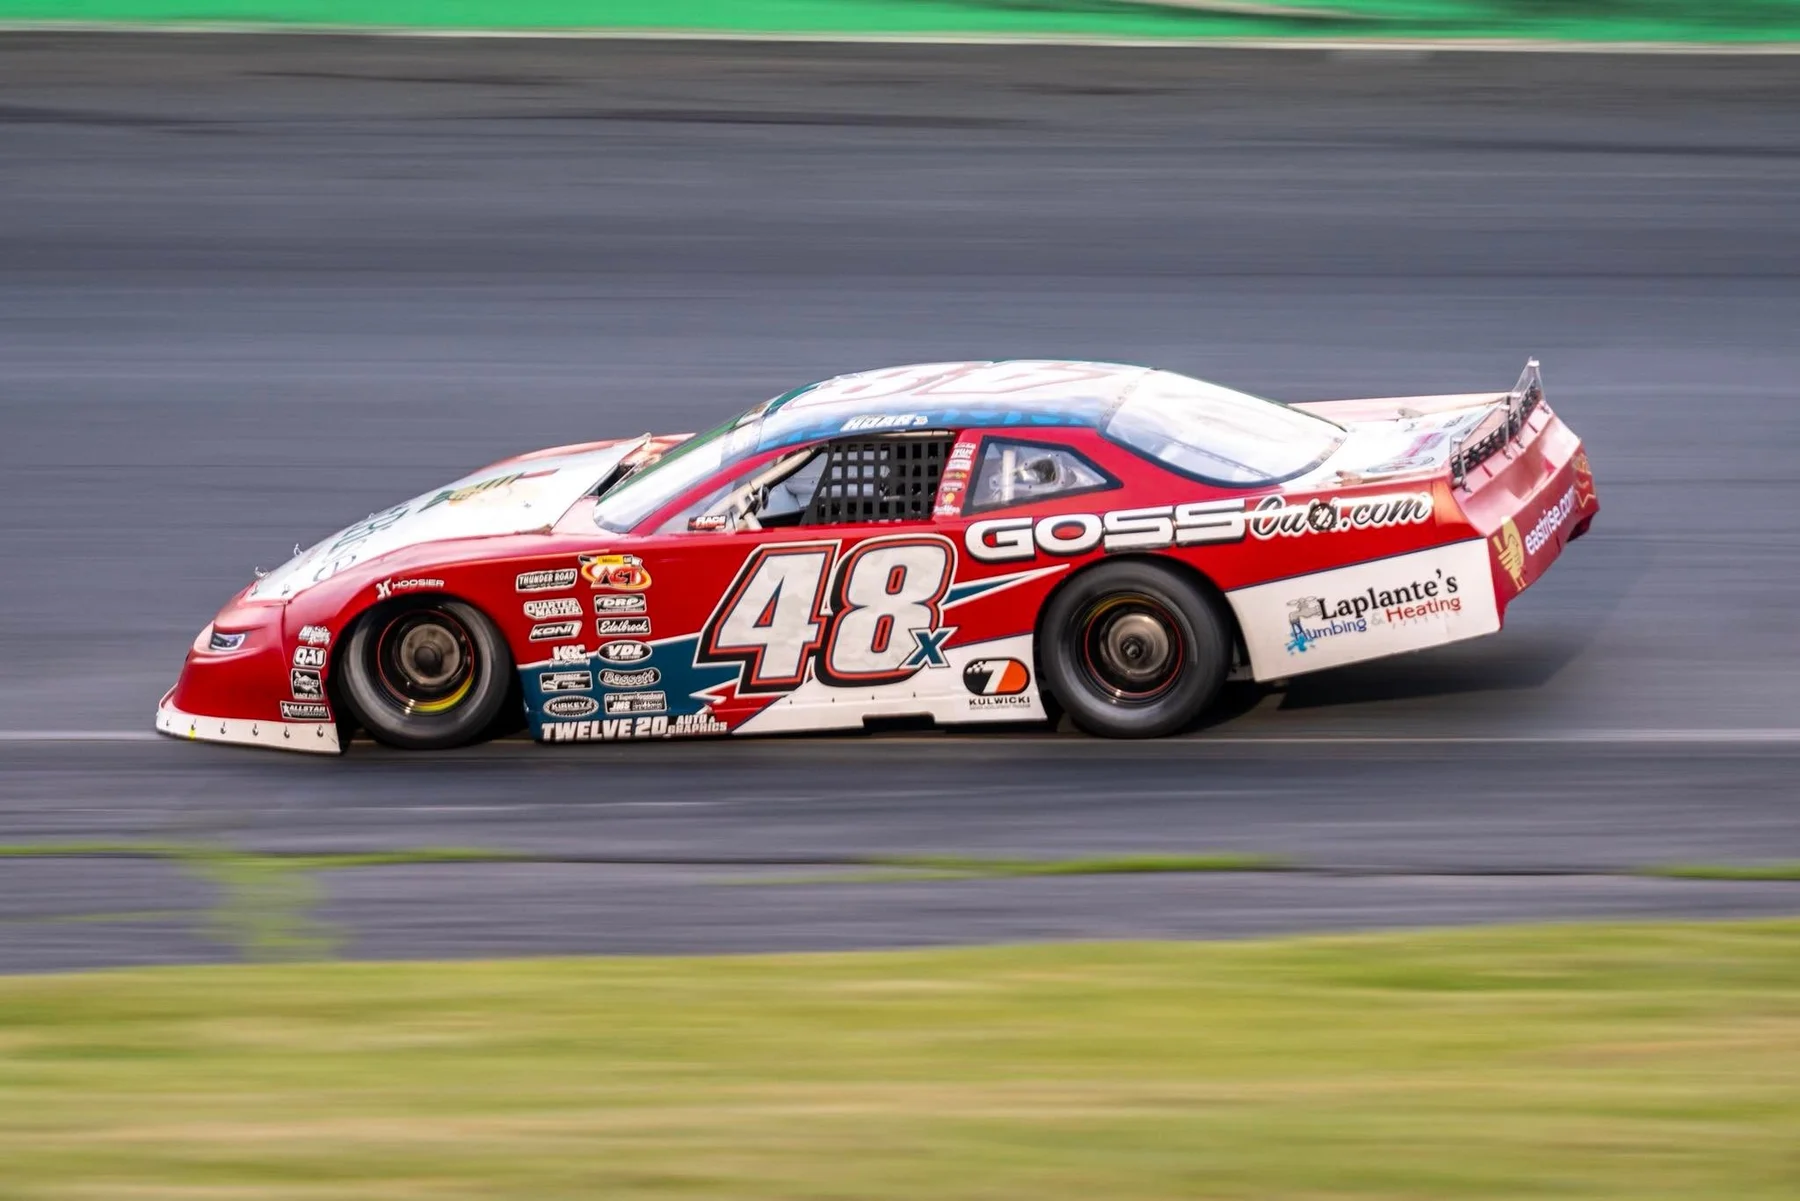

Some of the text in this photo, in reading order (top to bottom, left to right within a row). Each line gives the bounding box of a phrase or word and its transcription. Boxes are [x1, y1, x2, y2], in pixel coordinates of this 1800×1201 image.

[965, 499, 1246, 563] GOSS
[519, 573, 554, 585] THUNDER
[554, 571, 575, 581] ROAD
[593, 565, 643, 586] ACT
[392, 578, 445, 589] HOOSIER
[1317, 569, 1459, 620] Laplante's
[526, 600, 578, 614] QUARTER
[603, 597, 639, 607] DRP
[535, 606, 581, 618] MASTER
[706, 535, 957, 690] 48
[1386, 596, 1462, 623] Heating
[532, 624, 572, 637] KONI
[600, 619, 649, 634] Edelbrock
[295, 648, 324, 666] QA1
[553, 644, 586, 661] KRC
[609, 644, 643, 656] VDL
[294, 677, 320, 686] SUNOCO
[603, 669, 655, 684] Bassett
[551, 701, 586, 711] KIRKEY
[609, 700, 631, 711] JMS
[969, 696, 1031, 706] KULWICKI
[289, 705, 326, 713] ALLSTAR
[675, 713, 708, 725] AUTO
[541, 716, 668, 742] TWELVE 20
[668, 720, 728, 736] GRAPHICS
